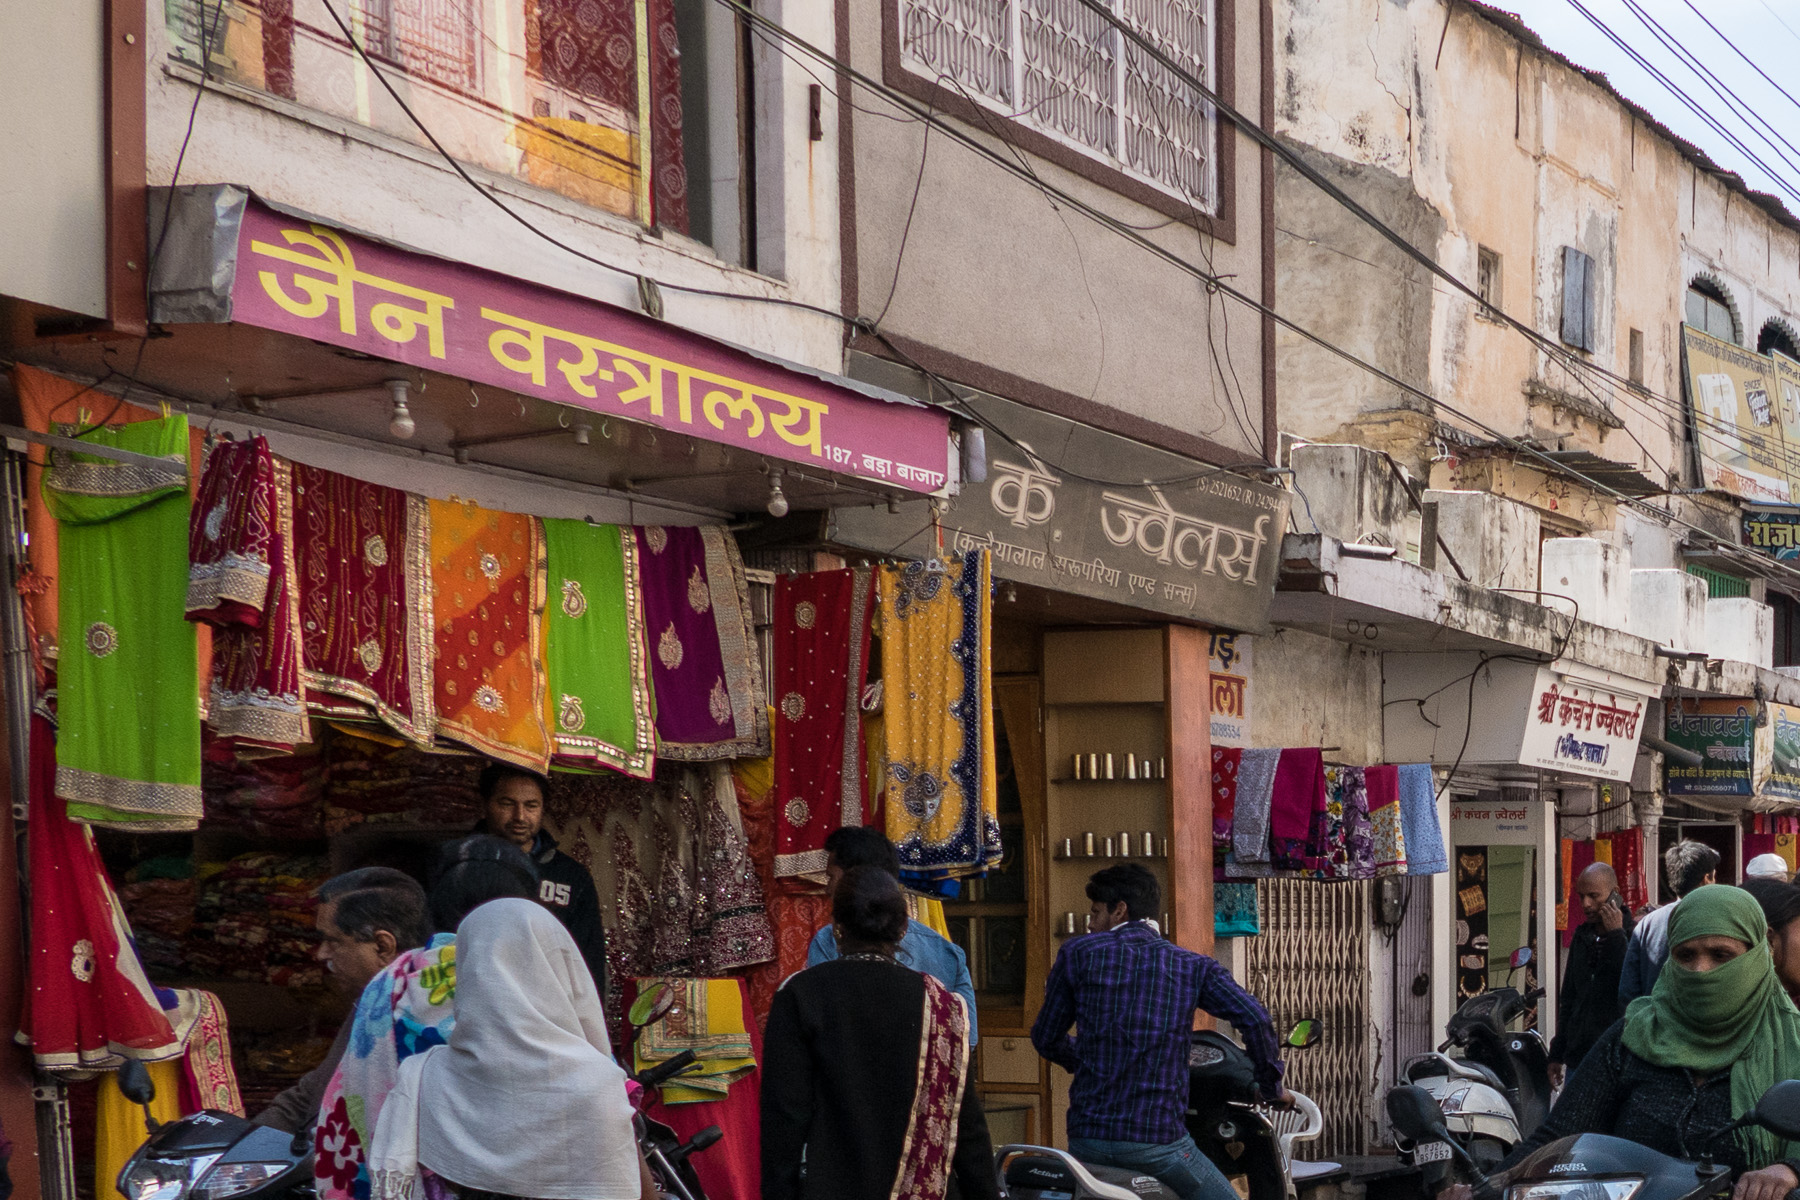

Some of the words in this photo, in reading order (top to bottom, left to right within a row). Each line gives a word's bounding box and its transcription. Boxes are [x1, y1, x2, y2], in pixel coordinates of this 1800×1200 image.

[251, 224, 454, 360] जैन
[480, 306, 829, 457] वस्त्रालय
[823, 445, 858, 470] 187,
[862, 453, 892, 478] बड़ा
[896, 462, 945, 489] बाजार
[1101, 480, 1270, 586] ज्वेलर्स
